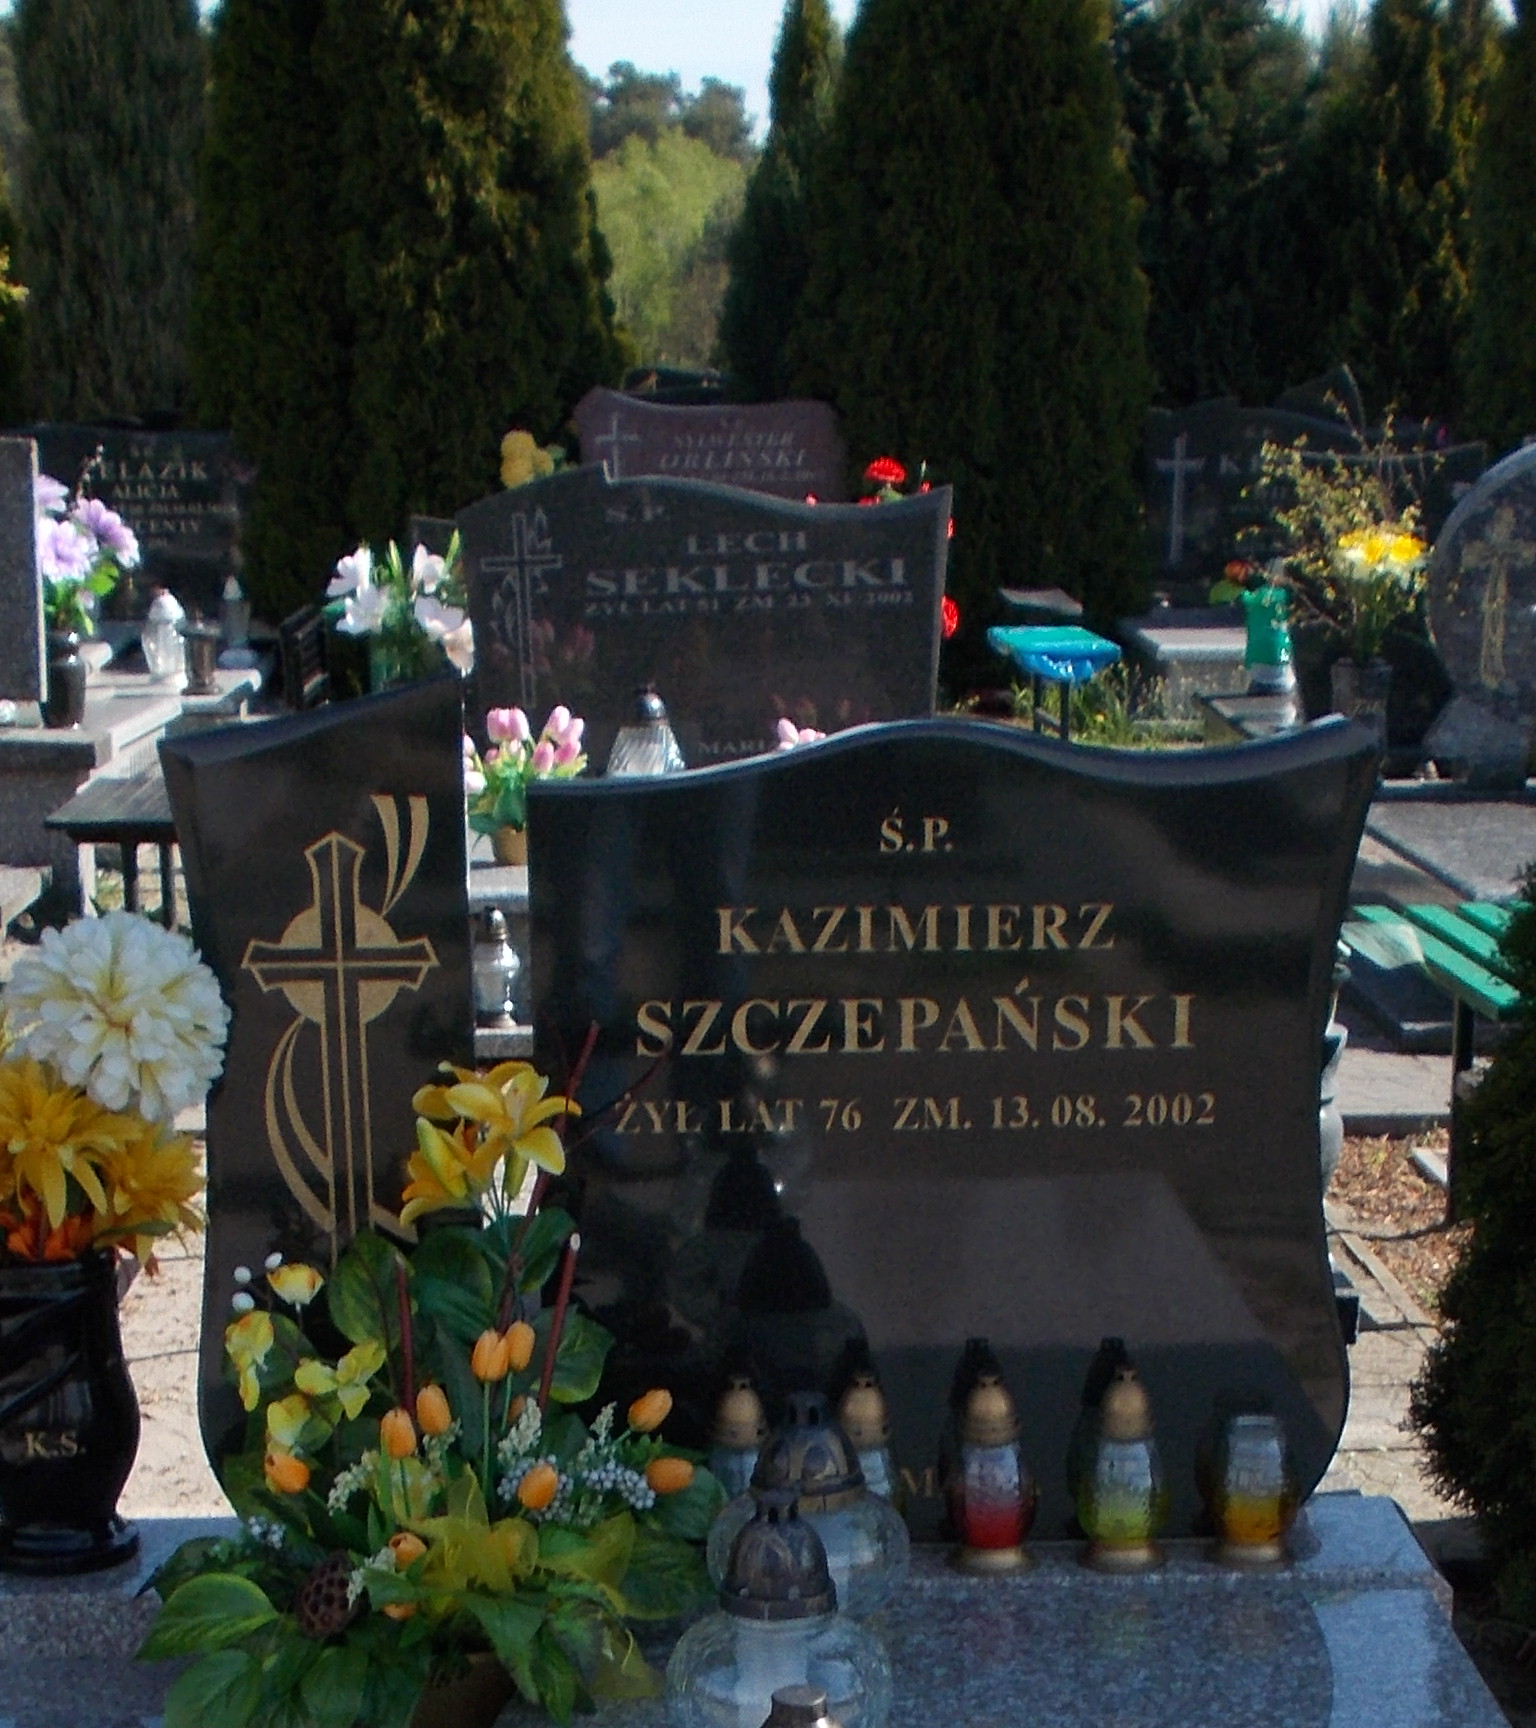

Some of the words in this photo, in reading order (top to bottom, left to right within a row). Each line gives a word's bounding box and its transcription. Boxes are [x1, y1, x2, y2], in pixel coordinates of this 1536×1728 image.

[686, 531, 808, 555] LECH
[585, 558, 907, 597] SEKLECKI
[879, 806, 954, 853] Ś.P.
[717, 903, 1116, 955] KAZIMIERZ
[635, 978, 1197, 1057] SZCZEPAŃSKI
[718, 1099, 805, 1133] LAT
[819, 1099, 864, 1132] 76
[892, 1097, 973, 1131] ZM.
[24, 1430, 88, 1459] K.S.
